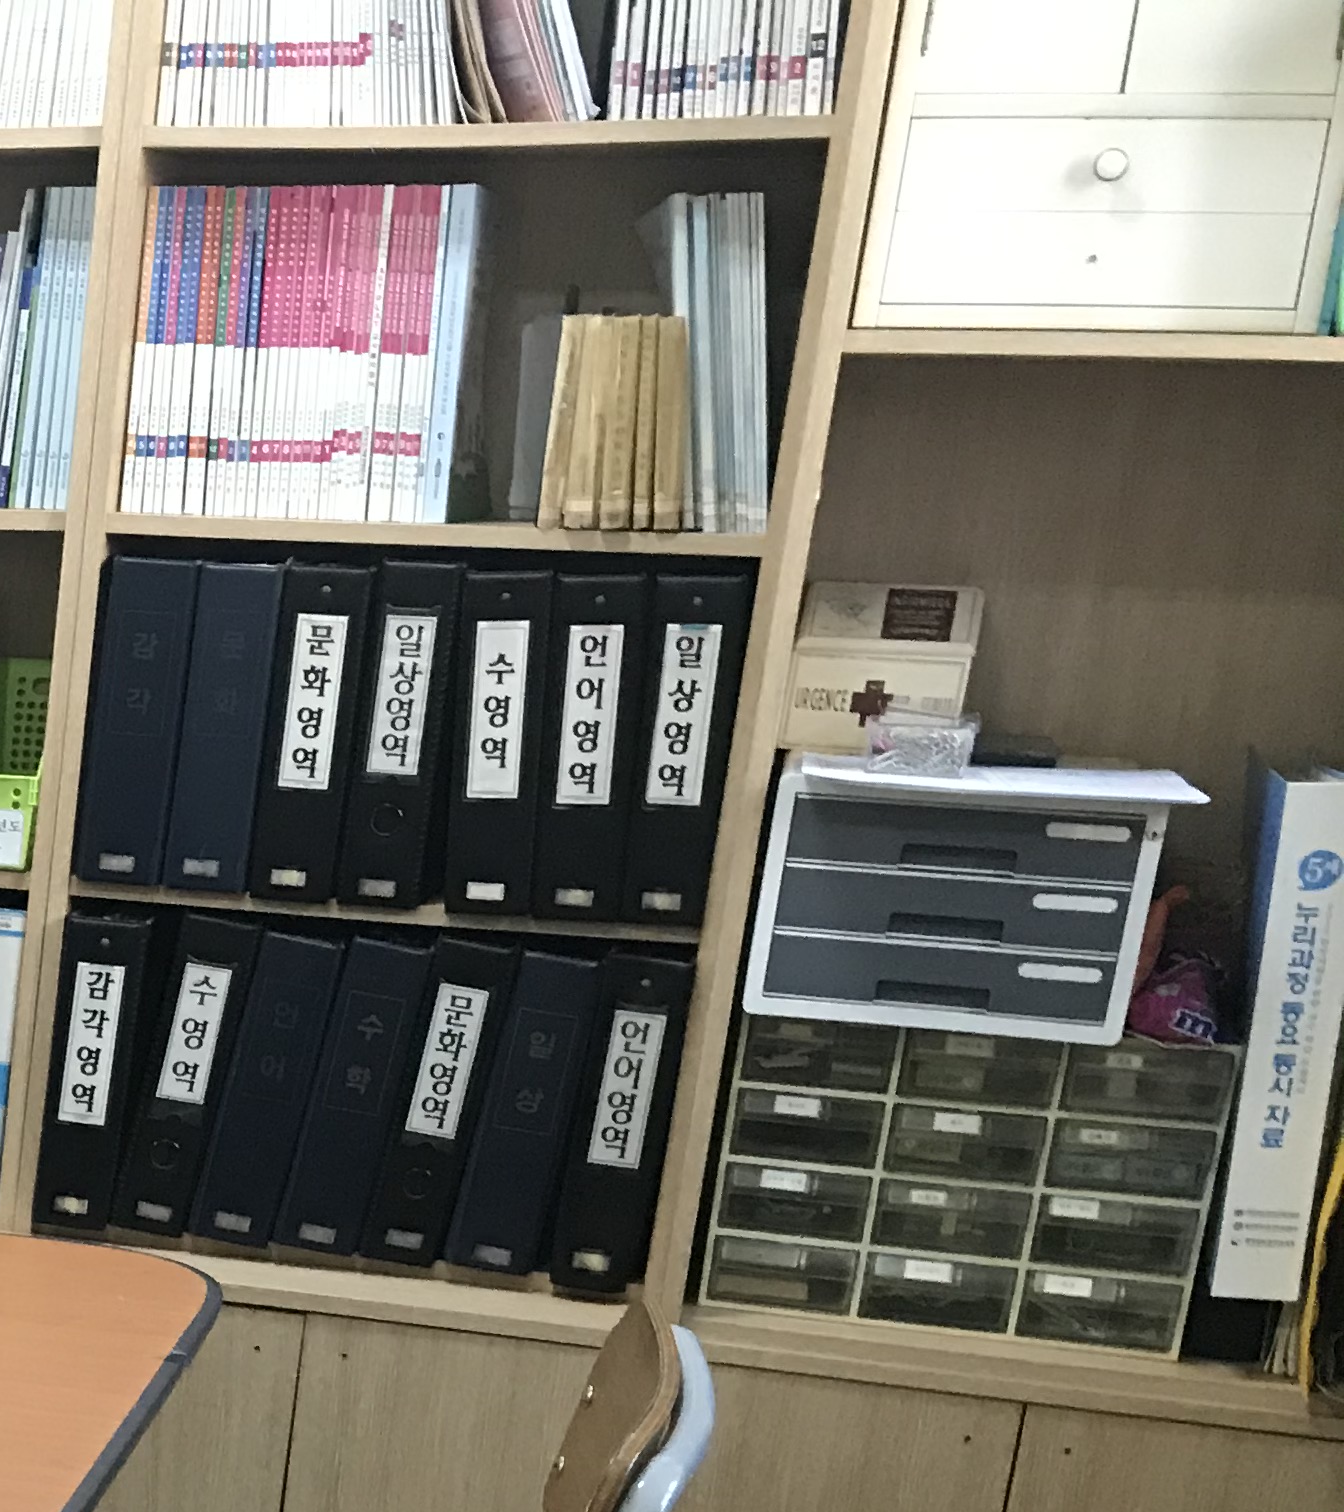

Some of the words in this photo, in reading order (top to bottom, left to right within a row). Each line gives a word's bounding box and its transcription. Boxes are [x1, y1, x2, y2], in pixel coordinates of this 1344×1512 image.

[292, 624, 334, 779] 문화영역
[381, 625, 426, 766] 일상영역
[482, 654, 515, 769] 수영역
[568, 636, 609, 794] 언어영역
[659, 636, 704, 796] 일상영역
[1287, 902, 1320, 996] 누리과정
[70, 972, 114, 1112] 감각영역
[173, 973, 217, 1092] 수영역
[421, 995, 474, 1128] 문화영역
[601, 1020, 652, 1158] 언어영역
[1259, 1104, 1291, 1149] 자료
